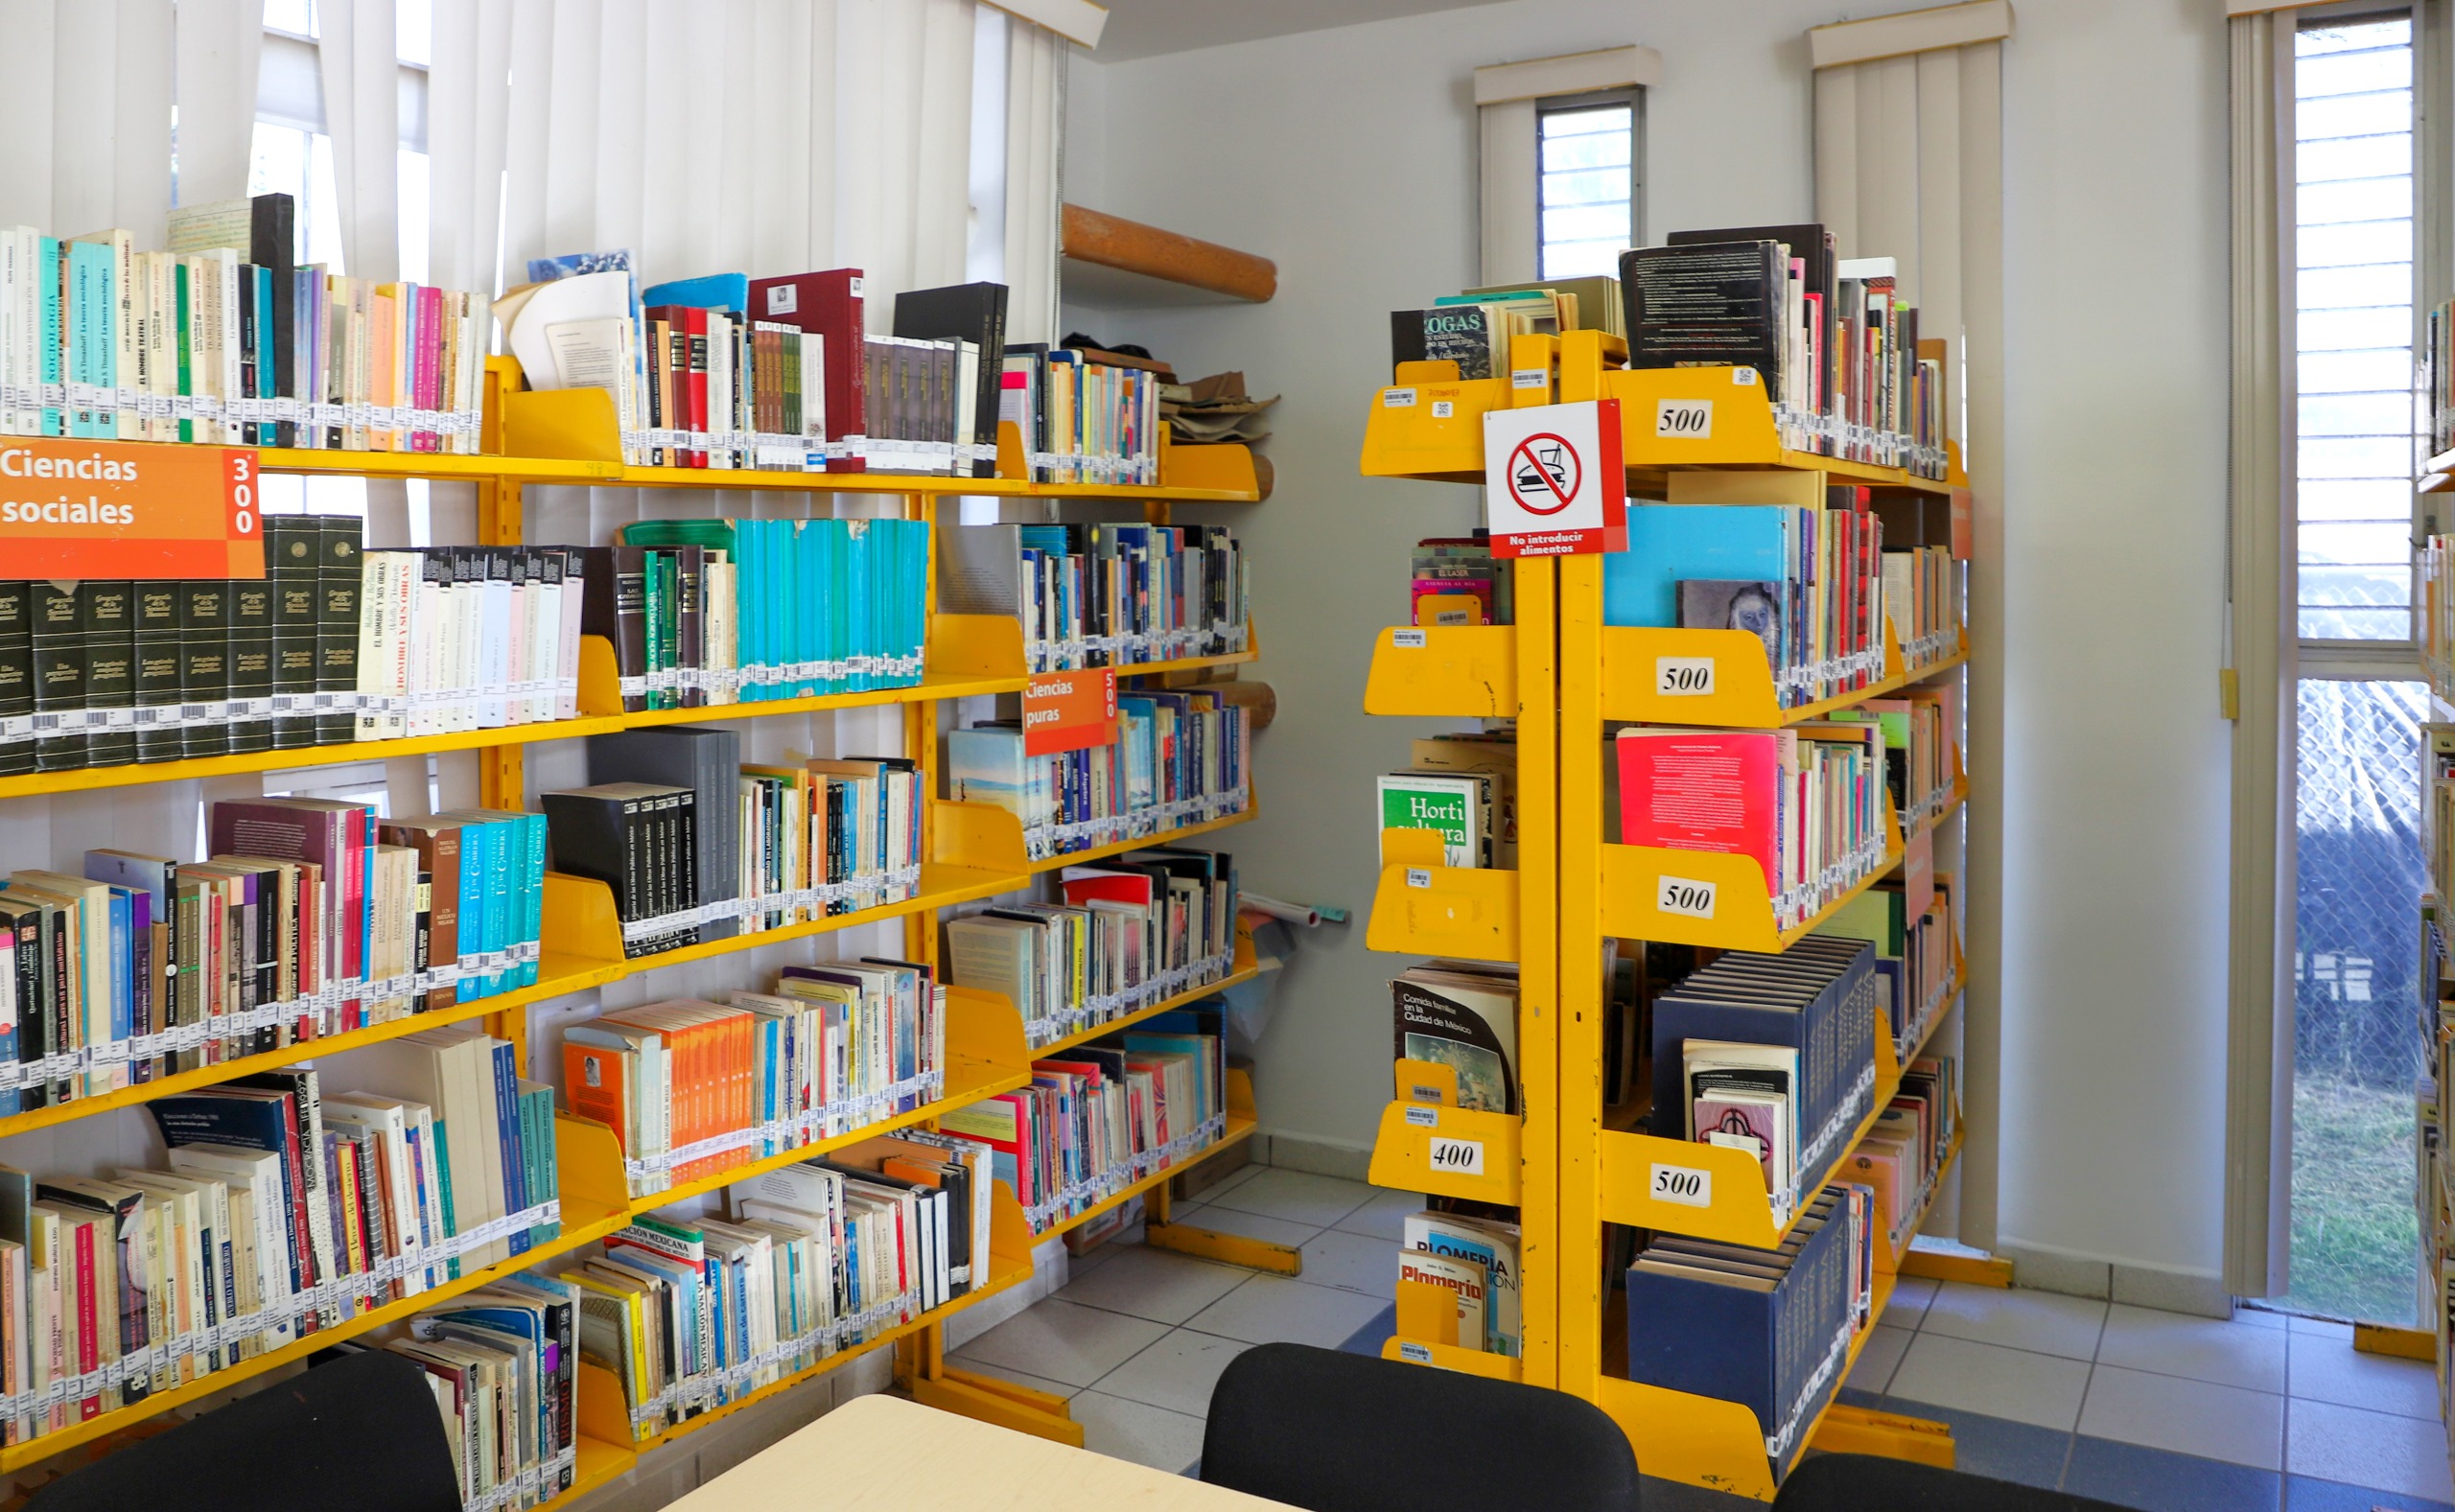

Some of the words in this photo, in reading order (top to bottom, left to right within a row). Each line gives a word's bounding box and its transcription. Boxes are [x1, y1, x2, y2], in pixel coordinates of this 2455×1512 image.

[1659, 409, 1705, 431] 500
[0, 449, 137, 481] Ciencias
[2, 495, 134, 524] sociales
[1509, 535, 1525, 546] No
[1527, 532, 1583, 545] introducir
[1520, 545, 1574, 555] alimentos
[400, 565, 409, 602] OBRAS
[1447, 569, 1469, 577] LASER
[397, 640, 407, 687] HOMBRE
[1025, 680, 1073, 698] Ciencias
[1663, 667, 1708, 690] 500
[1026, 709, 1060, 729] puras
[1411, 797, 1464, 821] Horti
[469, 834, 480, 876] CABRERA
[496, 829, 506, 872] CABRERA
[533, 824, 544, 865] CABRERA
[1664, 885, 1710, 911] 500
[1403, 993, 1433, 1008] Comida
[1433, 1000, 1457, 1014] familiar
[1415, 1006, 1423, 1014] la
[1404, 1012, 1433, 1024] Ciudad
[1434, 1017, 1443, 1027] de
[1445, 1019, 1472, 1035] México
[302, 1129, 316, 1200] DEMOCRACIA
[1434, 1144, 1474, 1167] 400
[1655, 1171, 1700, 1197] 500
[287, 1217, 295, 1235] Debate
[649, 1233, 690, 1251] MEXICANA
[223, 1245, 232, 1277] PRIMERO
[289, 1243, 297, 1269] Elecciones
[224, 1279, 233, 1289] ES
[698, 1281, 704, 1291] LA
[225, 1290, 235, 1316] PUEBLO
